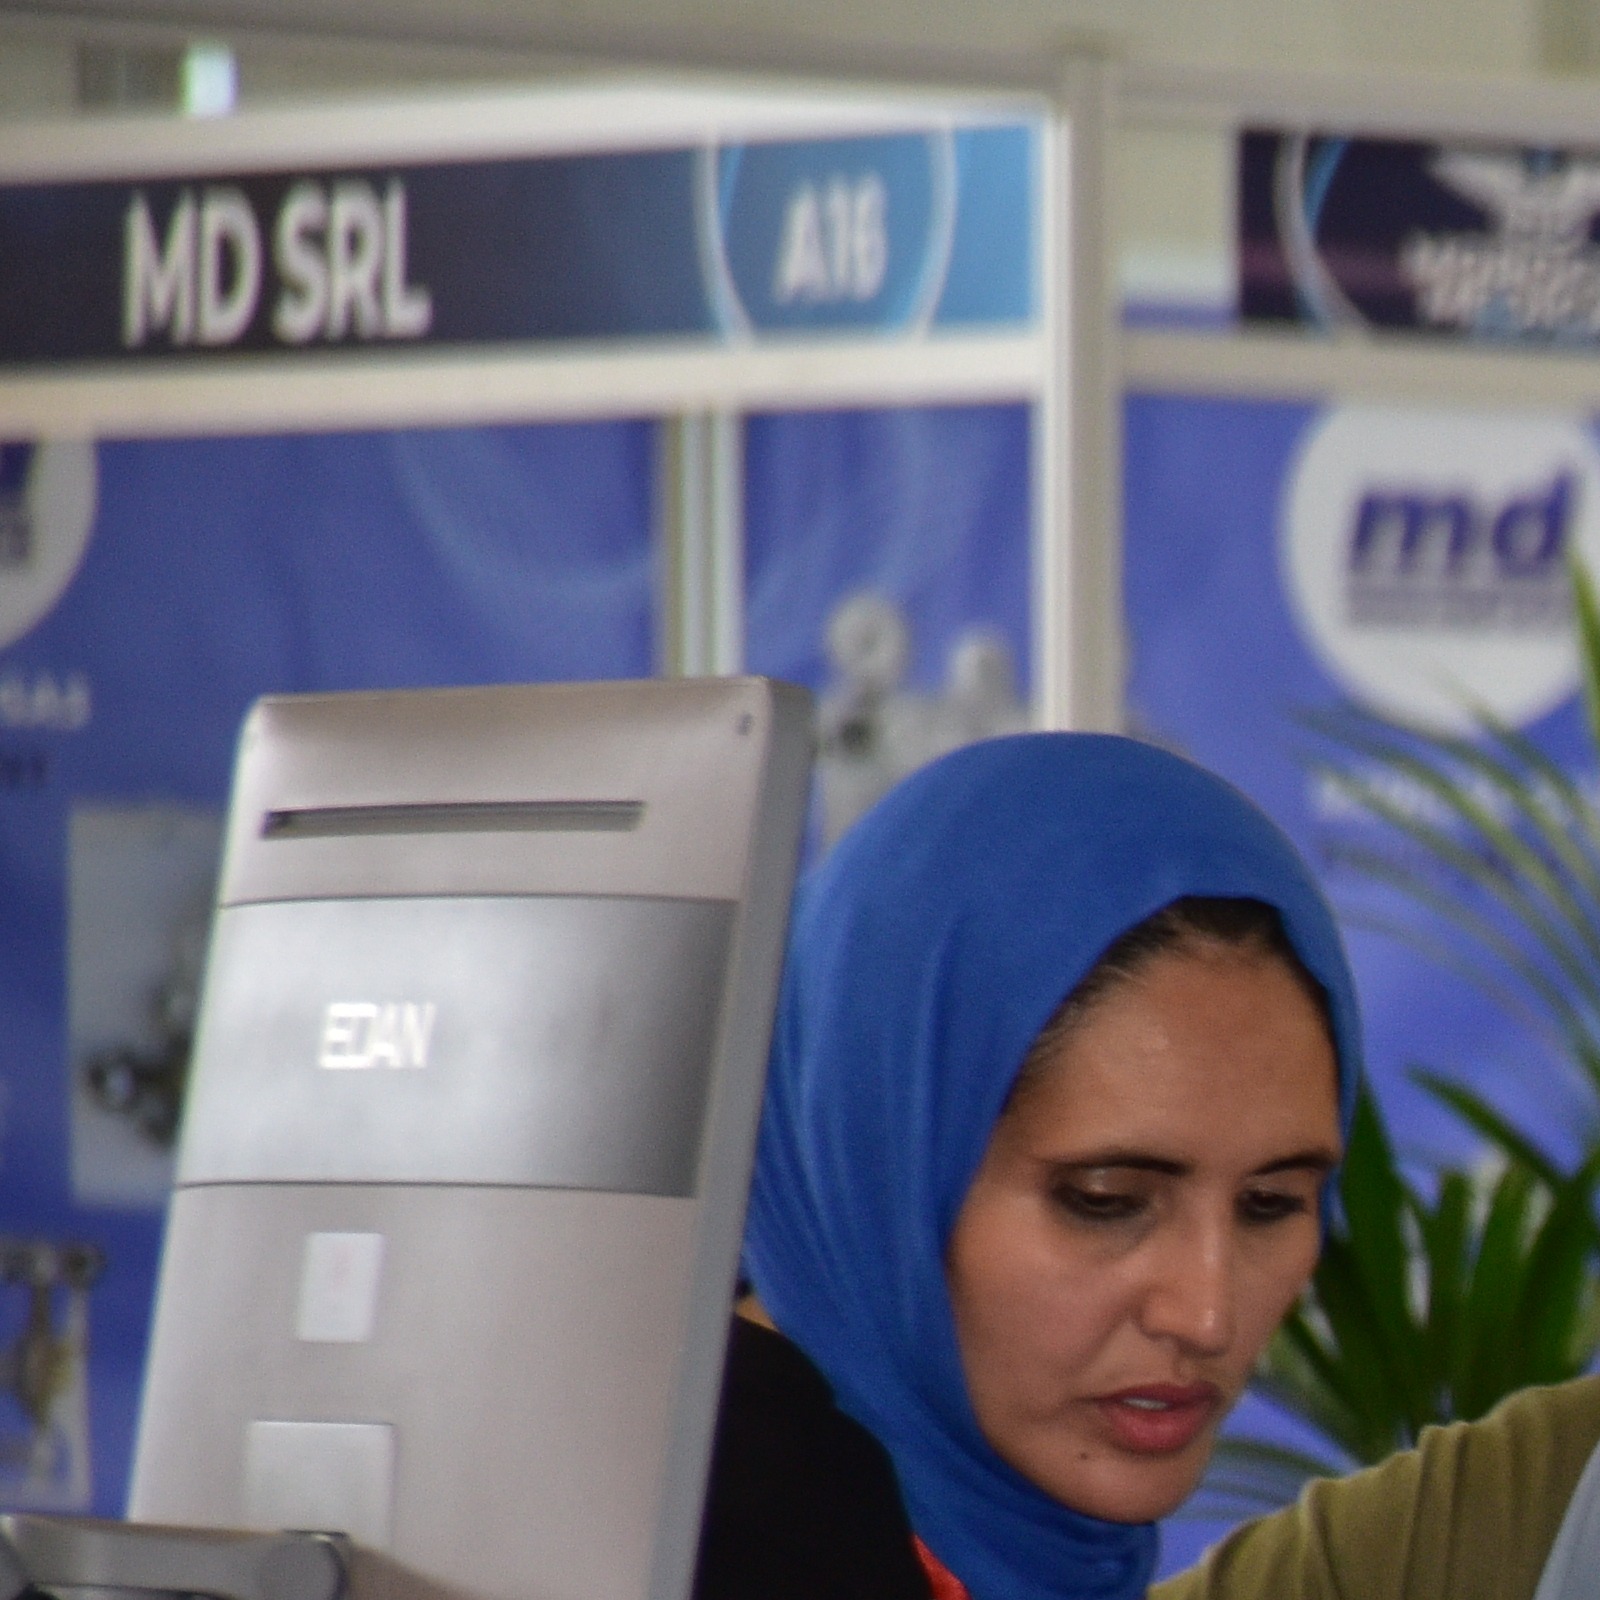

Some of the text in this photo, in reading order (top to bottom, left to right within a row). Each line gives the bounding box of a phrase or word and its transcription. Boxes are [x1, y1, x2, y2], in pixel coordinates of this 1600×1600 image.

[123, 178, 432, 349] MD SRL
[1350, 464, 1575, 579] md
[318, 1002, 437, 1071] EDAN
